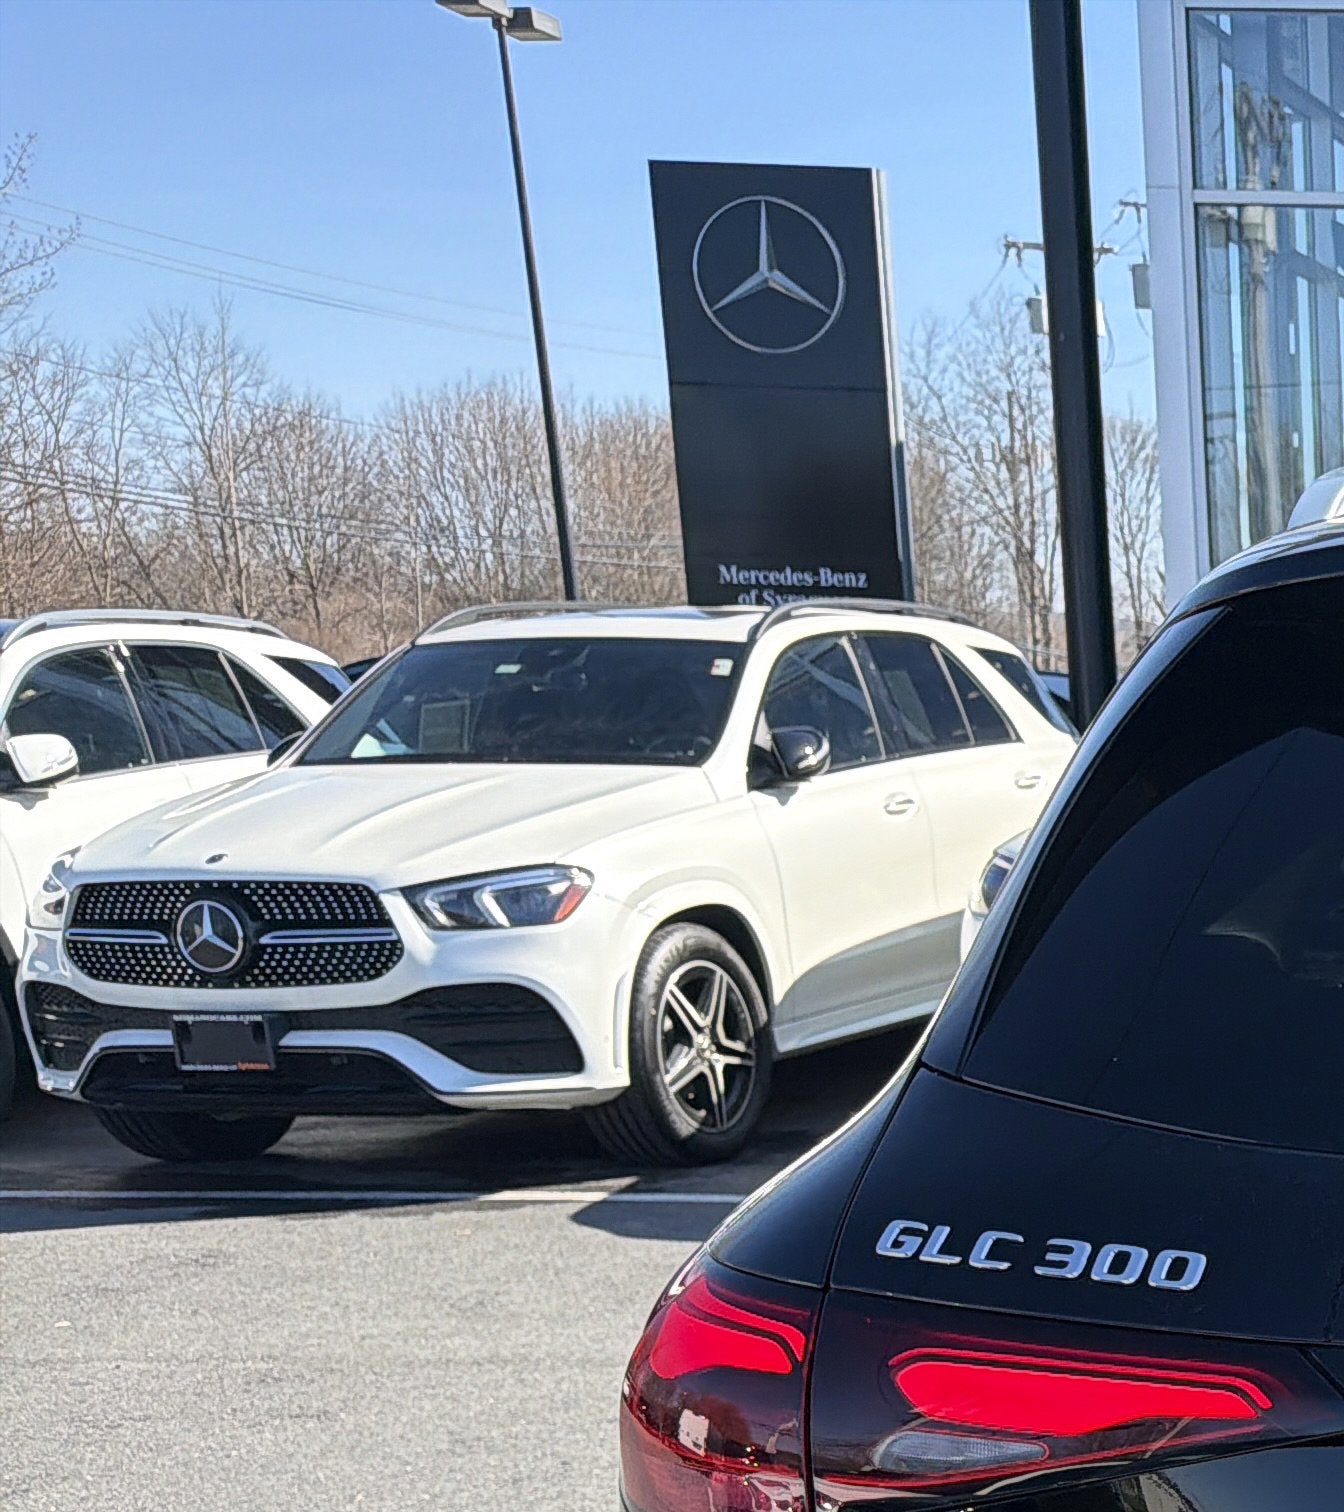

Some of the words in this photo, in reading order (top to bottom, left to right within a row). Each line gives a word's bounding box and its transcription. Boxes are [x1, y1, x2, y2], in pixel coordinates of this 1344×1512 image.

[718, 564, 869, 589] Mercedes-Benz
[875, 1219, 1025, 1270] GLC
[1033, 1238, 1208, 1291] 300
